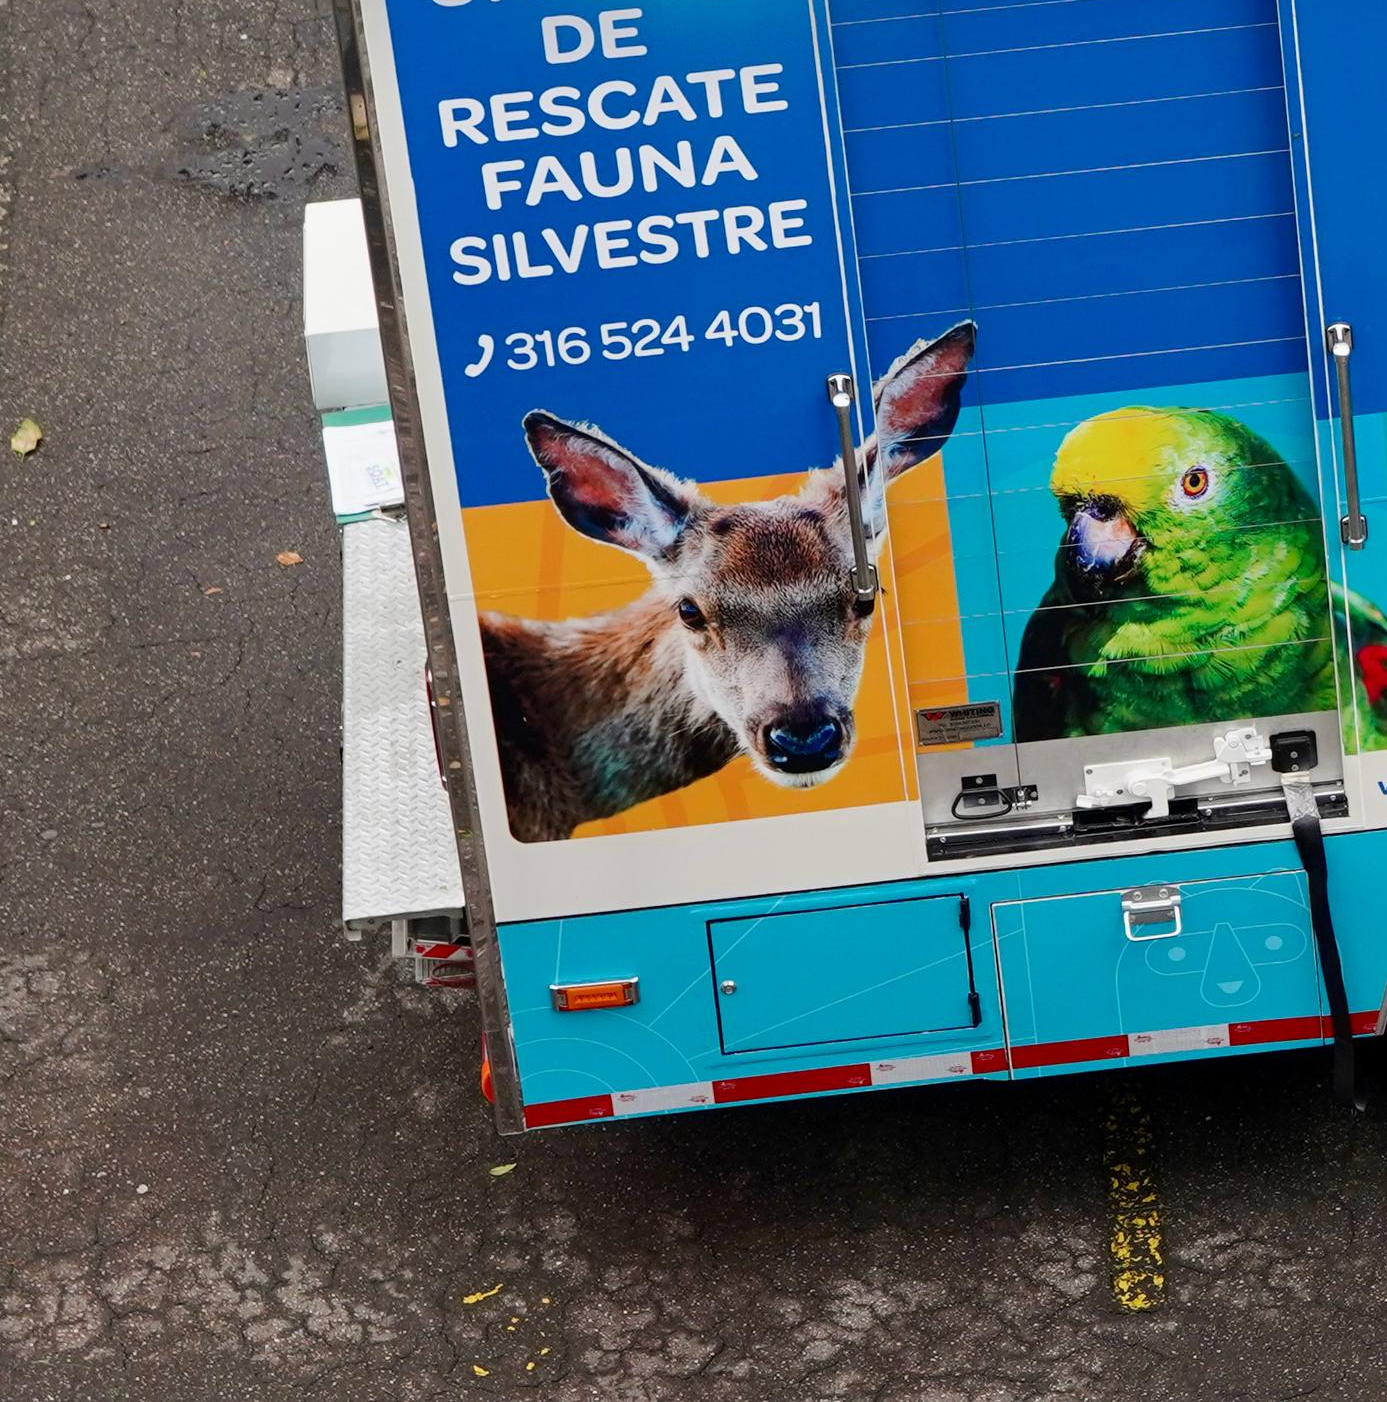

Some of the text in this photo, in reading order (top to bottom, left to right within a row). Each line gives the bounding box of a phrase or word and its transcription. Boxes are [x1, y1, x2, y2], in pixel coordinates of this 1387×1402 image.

[542, 8, 647, 64] DE
[439, 64, 788, 147] RESCATE
[482, 136, 758, 209] FAUNA
[450, 199, 812, 285] SILVESTRE
[506, 302, 822, 370] 316 524 4031
